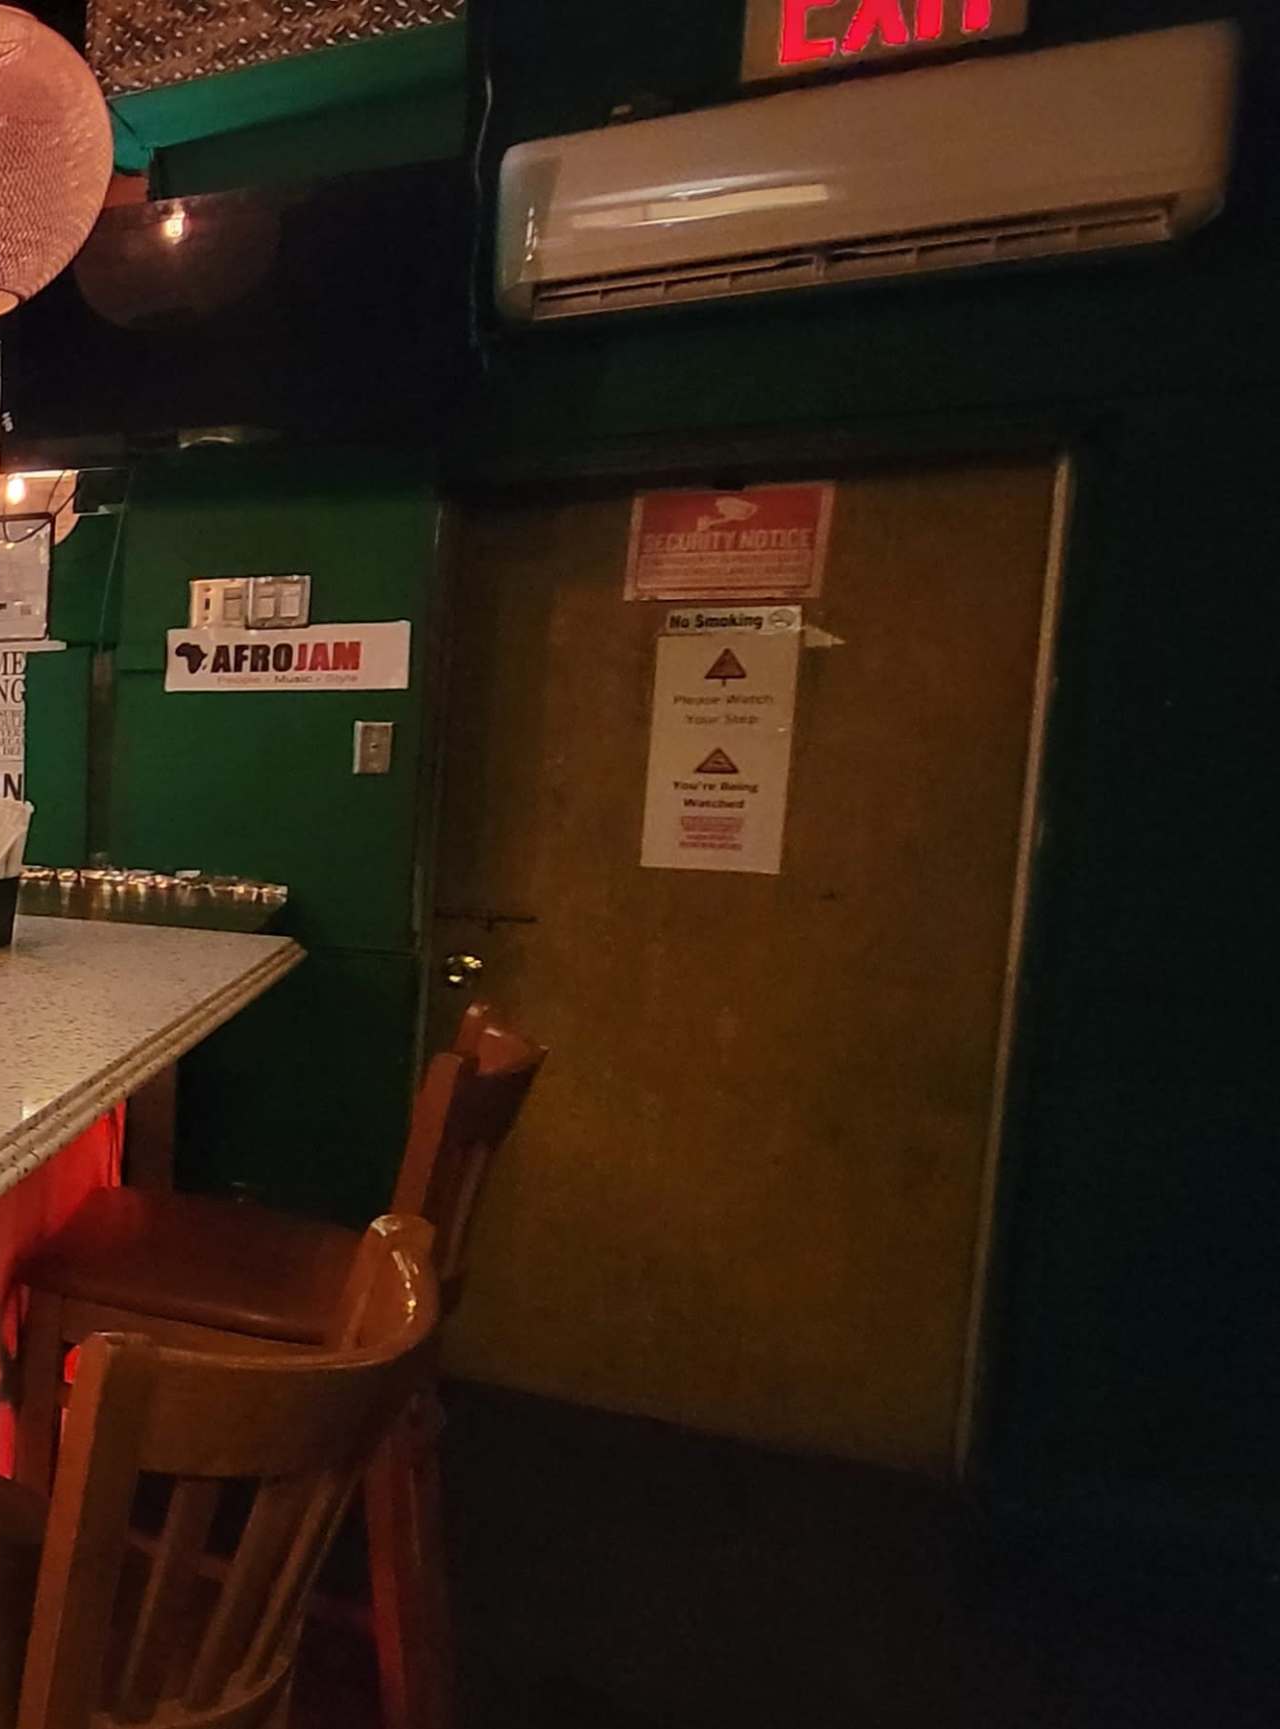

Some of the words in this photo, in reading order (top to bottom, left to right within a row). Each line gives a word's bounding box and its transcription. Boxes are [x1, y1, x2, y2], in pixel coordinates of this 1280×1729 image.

[778, 0, 992, 65] EX
[643, 531, 738, 552] SECURITY
[739, 528, 813, 549] NOTICE
[669, 615, 690, 629] No
[694, 613, 764, 630] Smoking
[210, 641, 362, 673] AFROJAM
[274, 675, 313, 684] Music
[672, 694, 721, 705] Please
[726, 694, 774, 705] Watch
[685, 715, 720, 725] Your
[724, 714, 759, 725] Step
[673, 781, 717, 791] You're
[720, 781, 759, 794] Being
[683, 798, 745, 809] Watched
